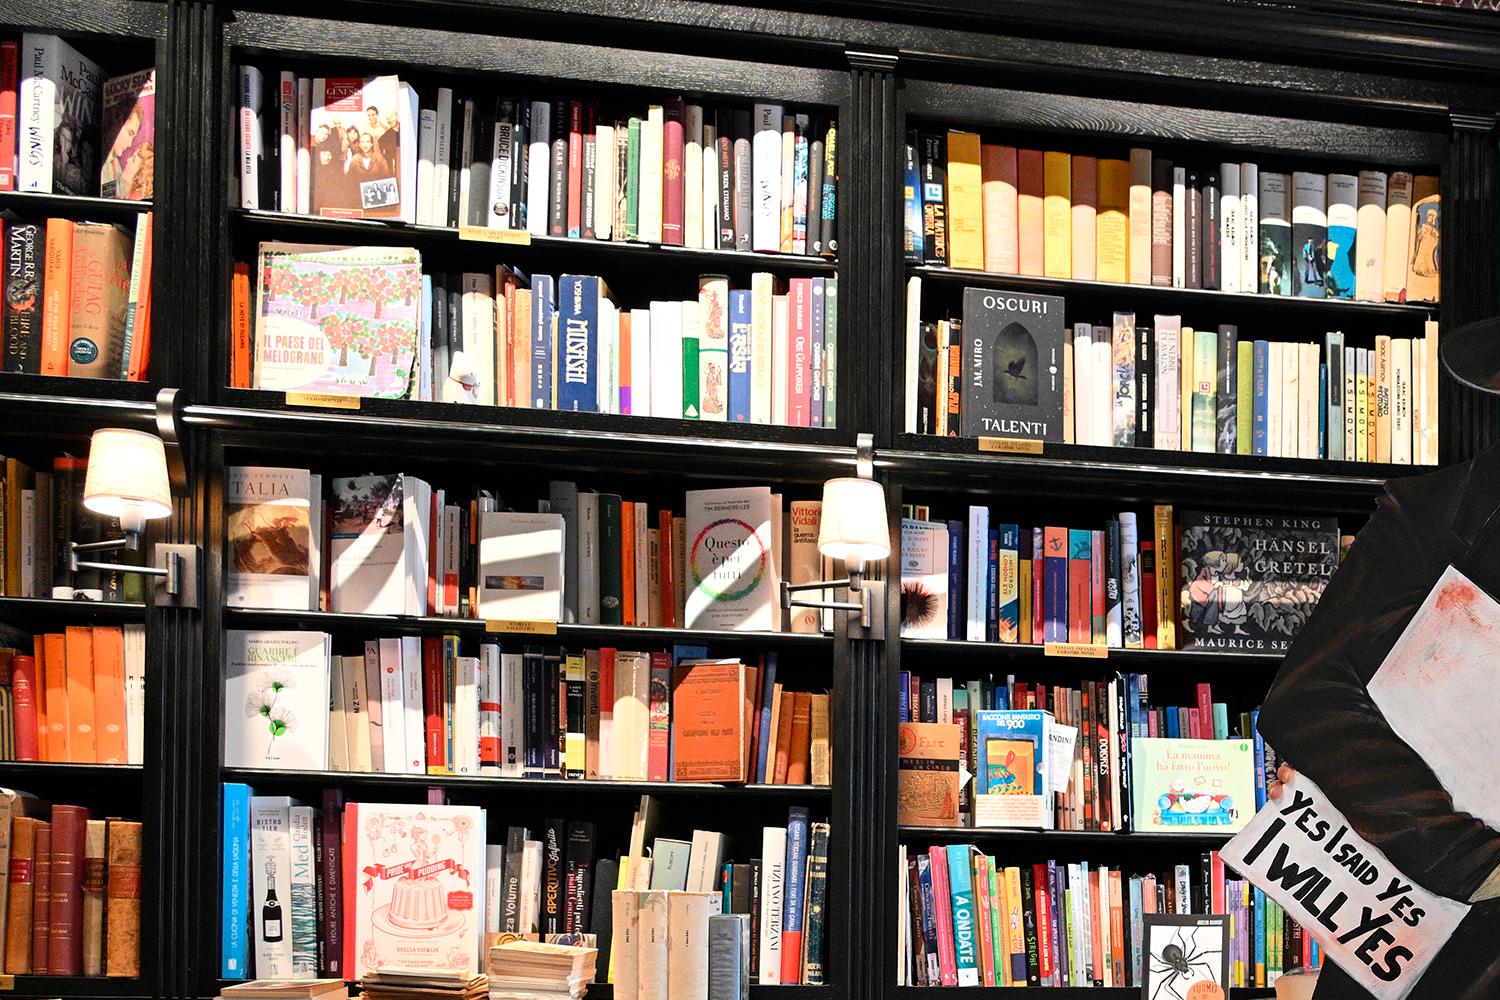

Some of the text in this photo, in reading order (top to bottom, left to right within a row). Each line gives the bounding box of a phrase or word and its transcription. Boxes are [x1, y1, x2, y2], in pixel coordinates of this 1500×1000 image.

[30, 48, 44, 123] Paul McCartney
[326, 87, 363, 97] GENESIS
[498, 125, 512, 154] BRUCE
[924, 204, 935, 235] OMBRA
[934, 204, 945, 216] LA
[10, 226, 26, 278] MARTIN
[24, 225, 37, 264] GEORGE
[983, 296, 1047, 314] OSCURI
[264, 335, 324, 350] IL PAESE DEL
[565, 318, 589, 384] MUSASHI
[263, 350, 324, 365] MELOGRANO
[973, 338, 983, 388] J.M. MIRO
[1160, 344, 1168, 375] AVALON
[981, 417, 1047, 436] TALENTI
[792, 507, 822, 517] Vittori
[792, 516, 817, 526] Vidali
[1203, 515, 1322, 530] STEPHEN KING
[704, 536, 750, 551] Questo
[1254, 537, 1331, 555] HÄNSEL
[1254, 561, 1332, 577] GRETEL
[247, 646, 290, 656] GUARIRE
[1194, 637, 1265, 650] MAURICE
[982, 713, 1012, 721] RACCONTI
[1007, 720, 1025, 729] 900
[1099, 738, 1109, 775] DOLORES
[1156, 761, 1232, 772] ha fatto l'uovo!
[1166, 750, 1221, 761] La mamma
[300, 816, 308, 840] Roden
[293, 845, 309, 878] Med
[386, 860, 446, 878] PRIDE PUDDING
[547, 826, 560, 914] APERITIVO Infinito
[1279, 789, 1427, 928] YES I SAID YES
[567, 873, 576, 895] piatti
[575, 868, 585, 911] ingredienti
[231, 884, 239, 908] VENEZIA
[329, 847, 337, 945] VERDURE ANTICHE DIMENTICATE
[505, 877, 518, 916] Volume
[769, 862, 782, 951] TIZIANO TERZANI
[1241, 817, 1415, 983] I WILL YES
[231, 917, 239, 940] CUCINA
[955, 895, 974, 964] A ONDATE
[1026, 936, 1038, 967] STREGHE
